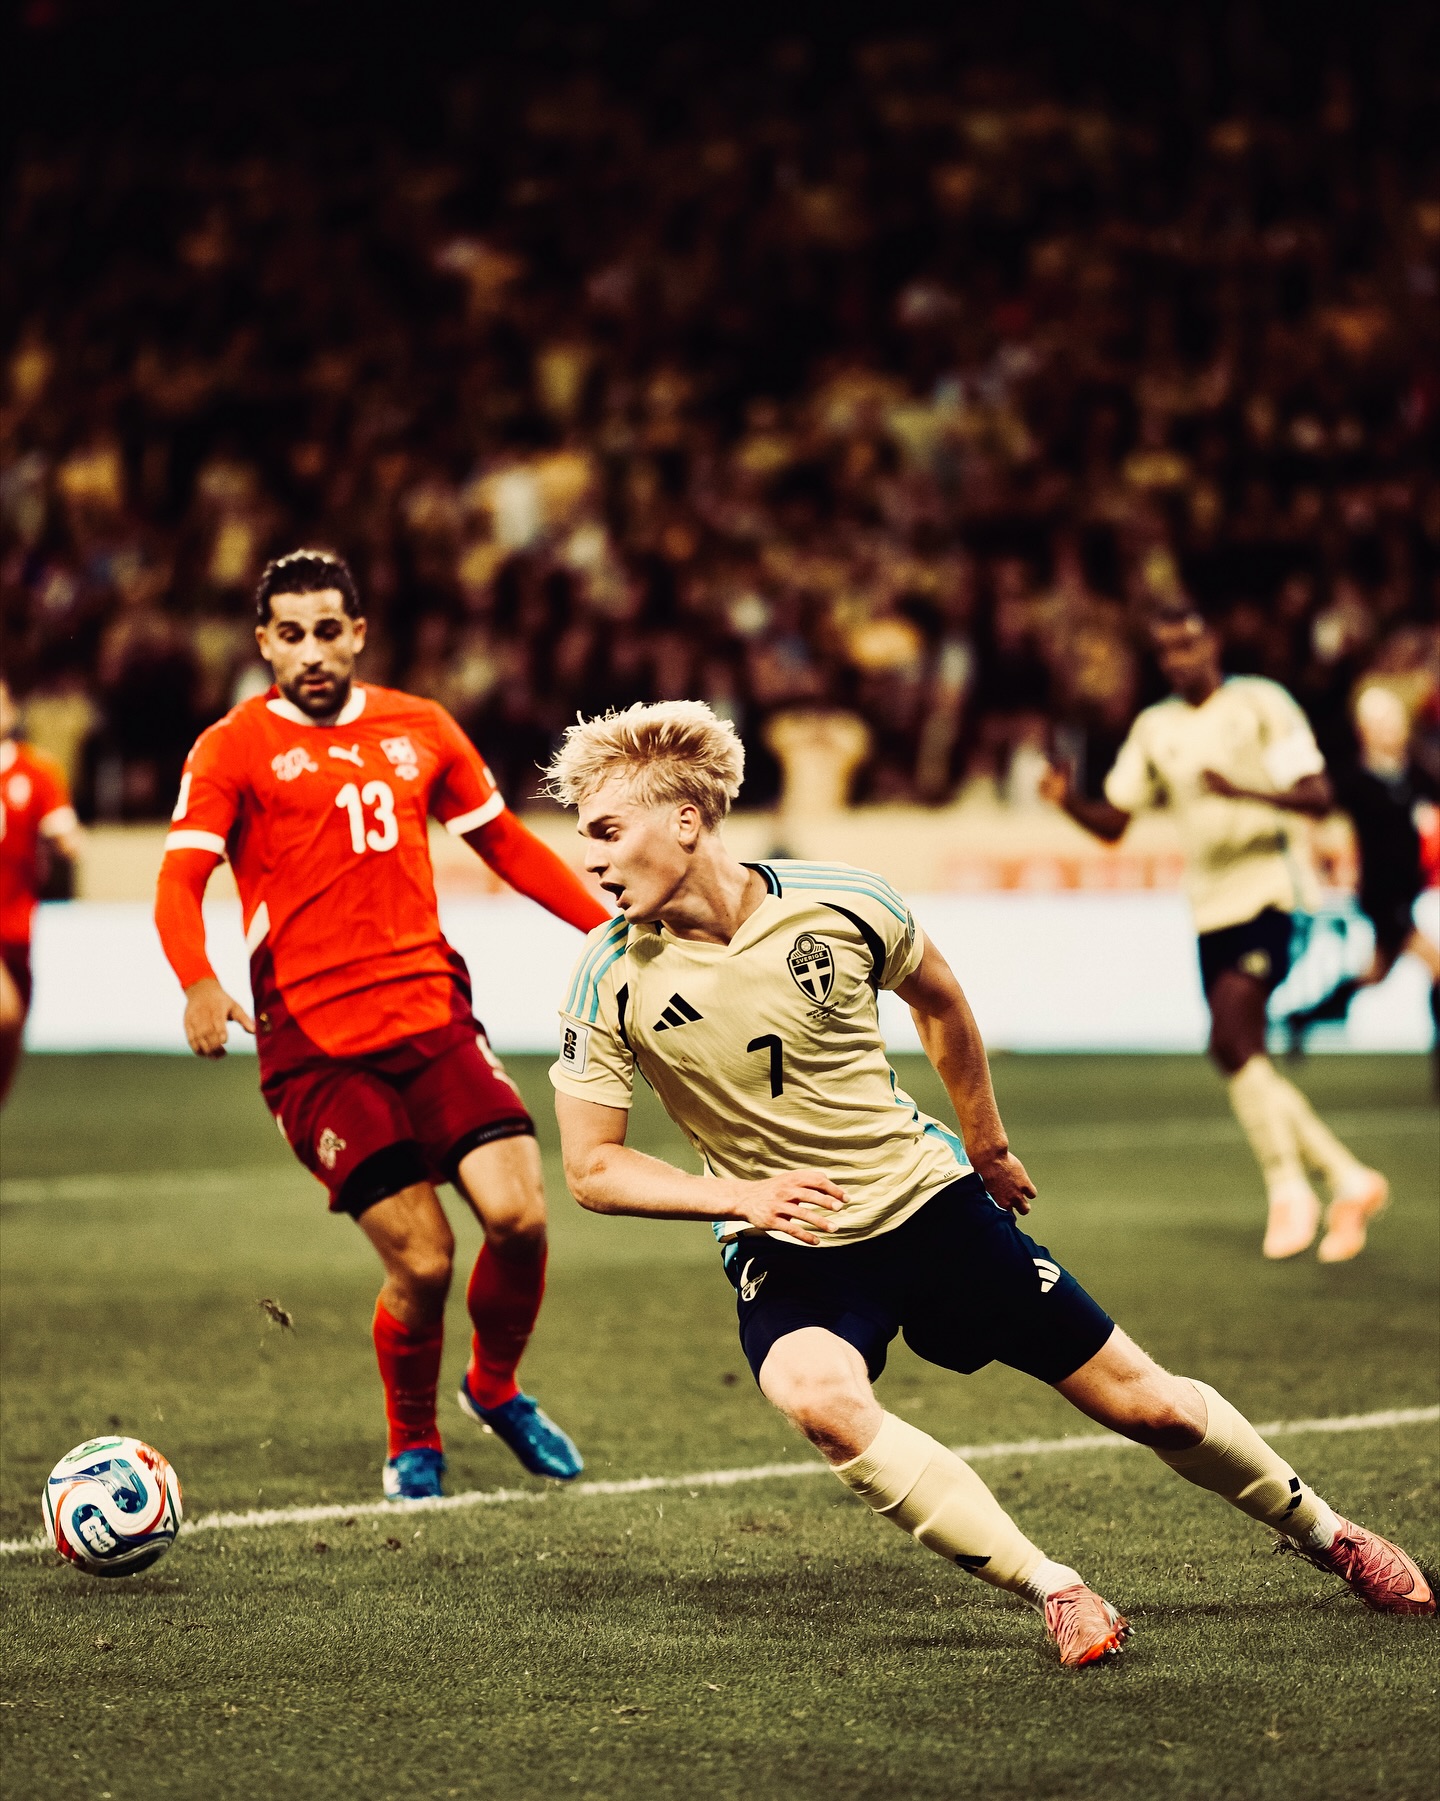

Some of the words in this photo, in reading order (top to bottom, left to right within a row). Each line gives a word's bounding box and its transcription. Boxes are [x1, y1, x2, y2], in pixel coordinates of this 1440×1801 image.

[335, 780, 399, 854] 13
[795, 951, 824, 965] SVERIGE
[746, 1033, 784, 1099] 7
